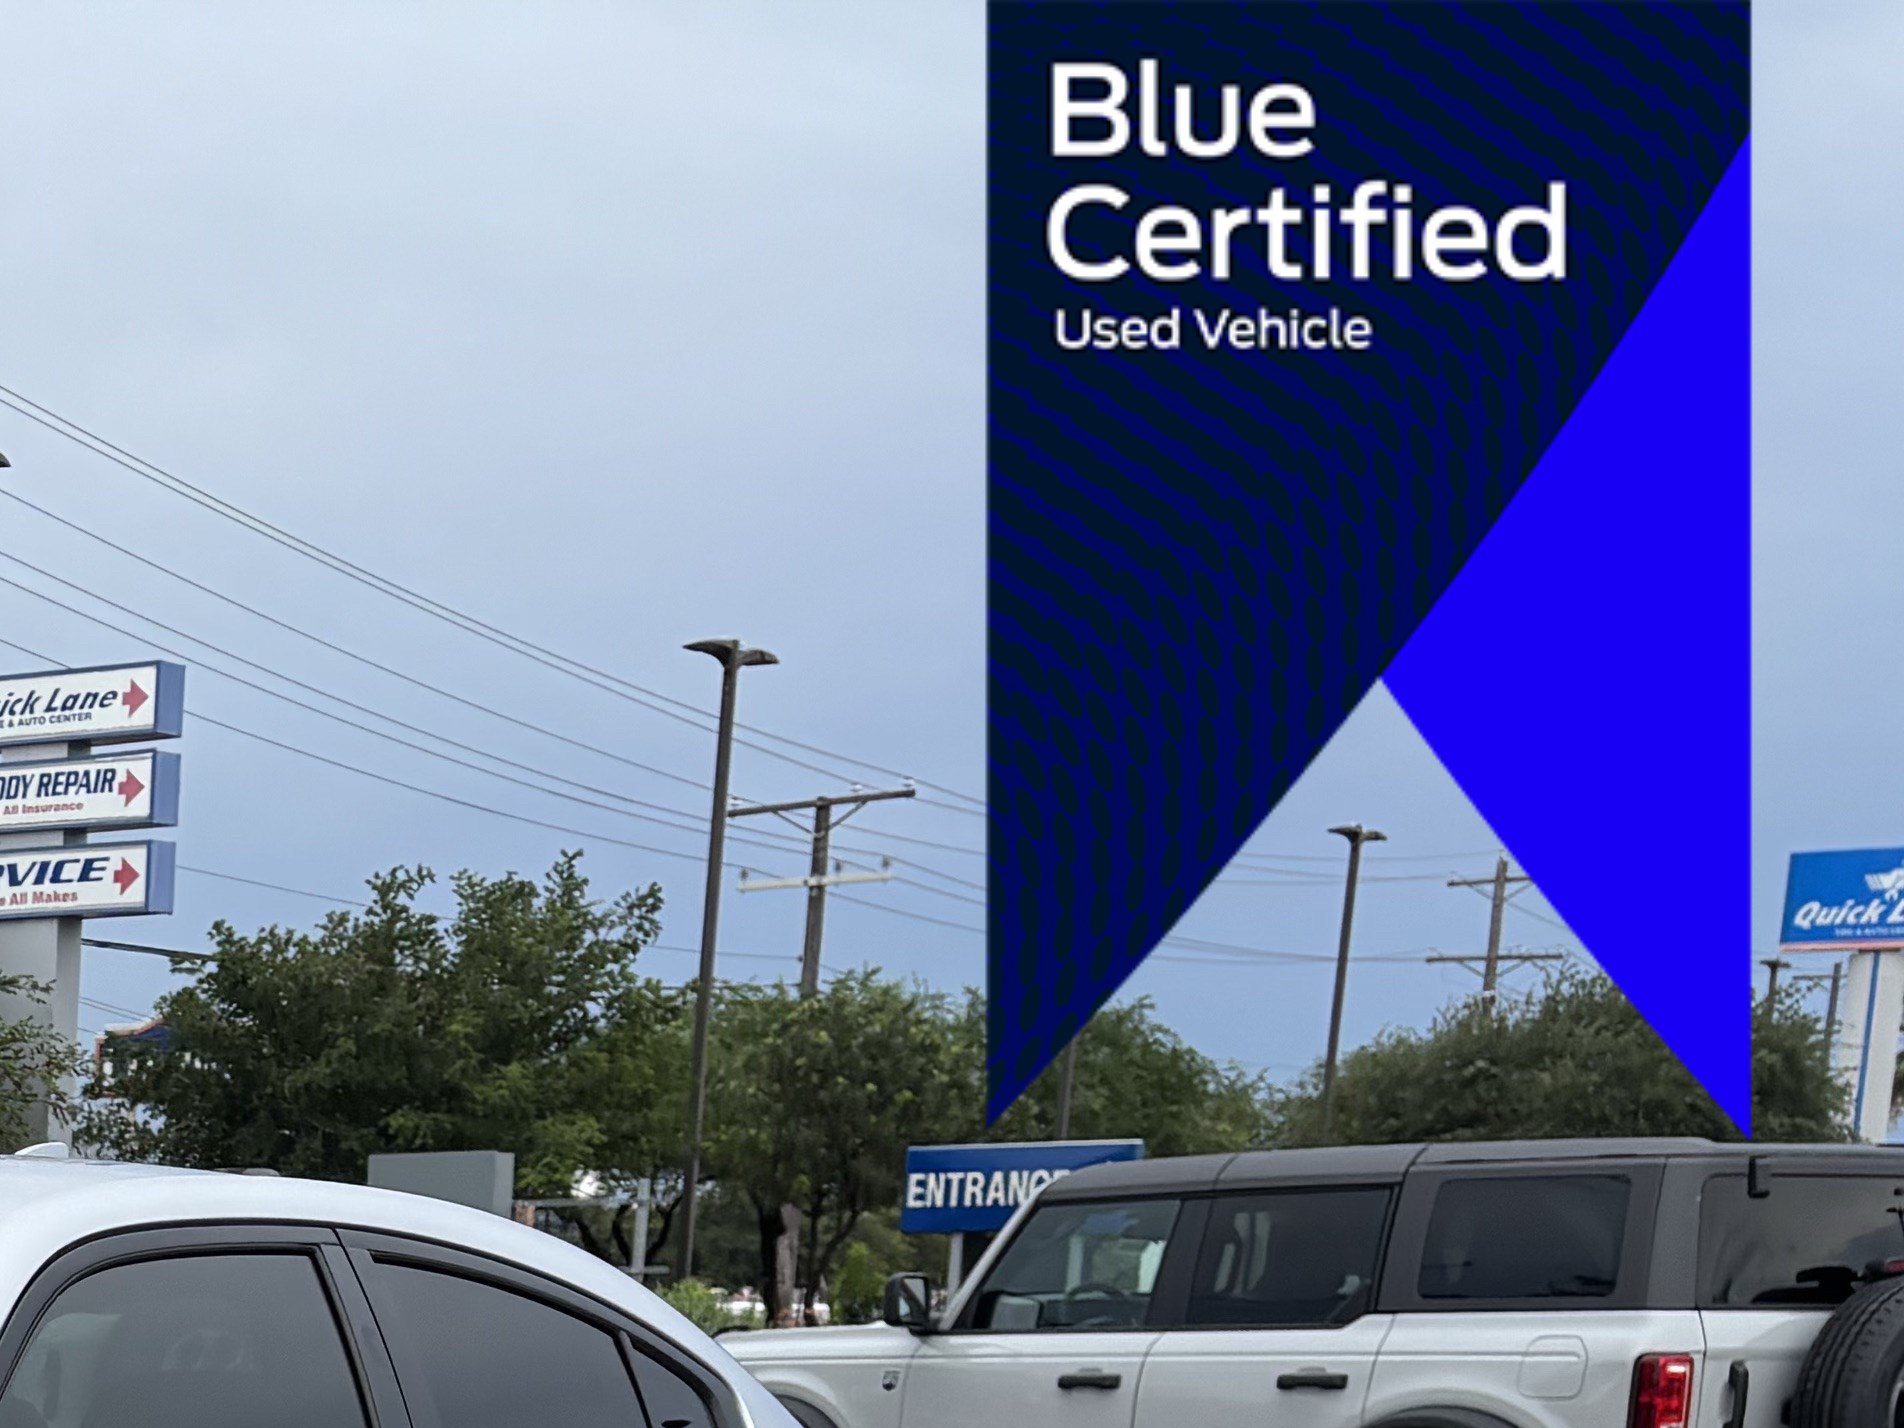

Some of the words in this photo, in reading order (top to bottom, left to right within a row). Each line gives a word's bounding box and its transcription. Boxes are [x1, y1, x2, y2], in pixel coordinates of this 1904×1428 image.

[44, 687, 119, 714] Lane
[7, 718, 14, 728] &
[18, 716, 47, 727] AUTO
[49, 712, 93, 723] CENTER
[36, 768, 117, 798] REPAIR
[3, 804, 19, 815] All
[22, 801, 84, 814] Insurance
[9, 891, 28, 906] All
[32, 890, 79, 904] Makes
[1793, 898, 1887, 930] Quick
[905, 1168, 1071, 1209] ENTRANC
